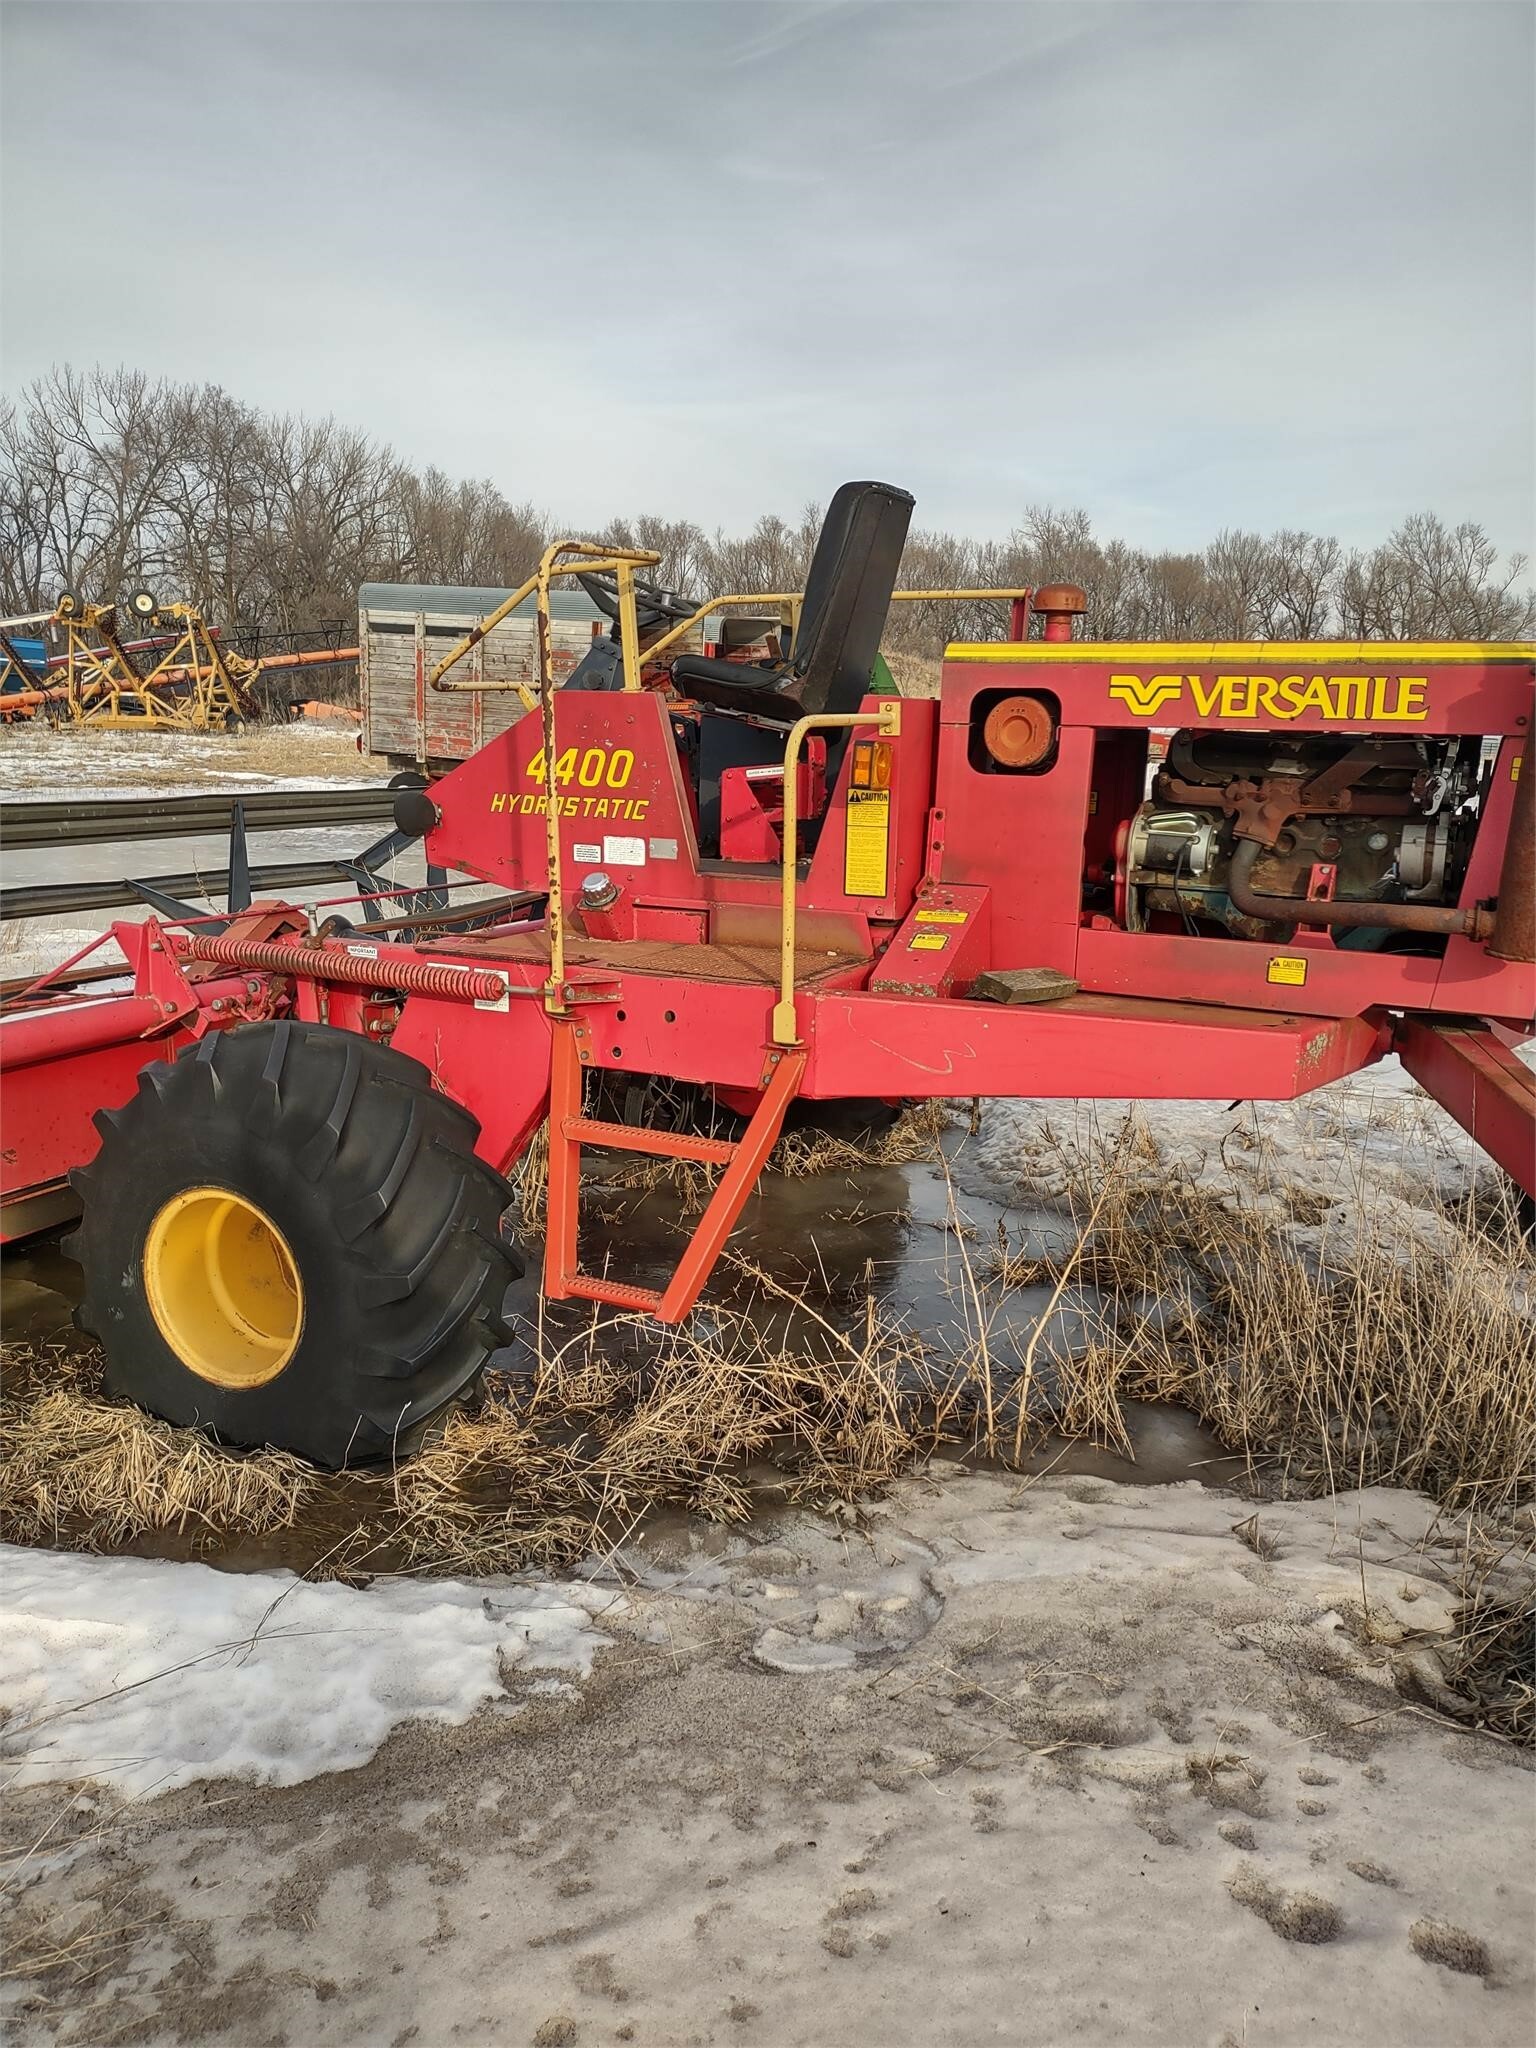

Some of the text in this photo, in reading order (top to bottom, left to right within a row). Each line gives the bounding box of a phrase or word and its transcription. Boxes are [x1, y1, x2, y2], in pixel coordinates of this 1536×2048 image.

[1186, 675, 1430, 720] VERSATILE
[526, 747, 635, 788] 4400
[861, 792, 888, 802] CAUTION
[1282, 960, 1304, 969] CAUTION
